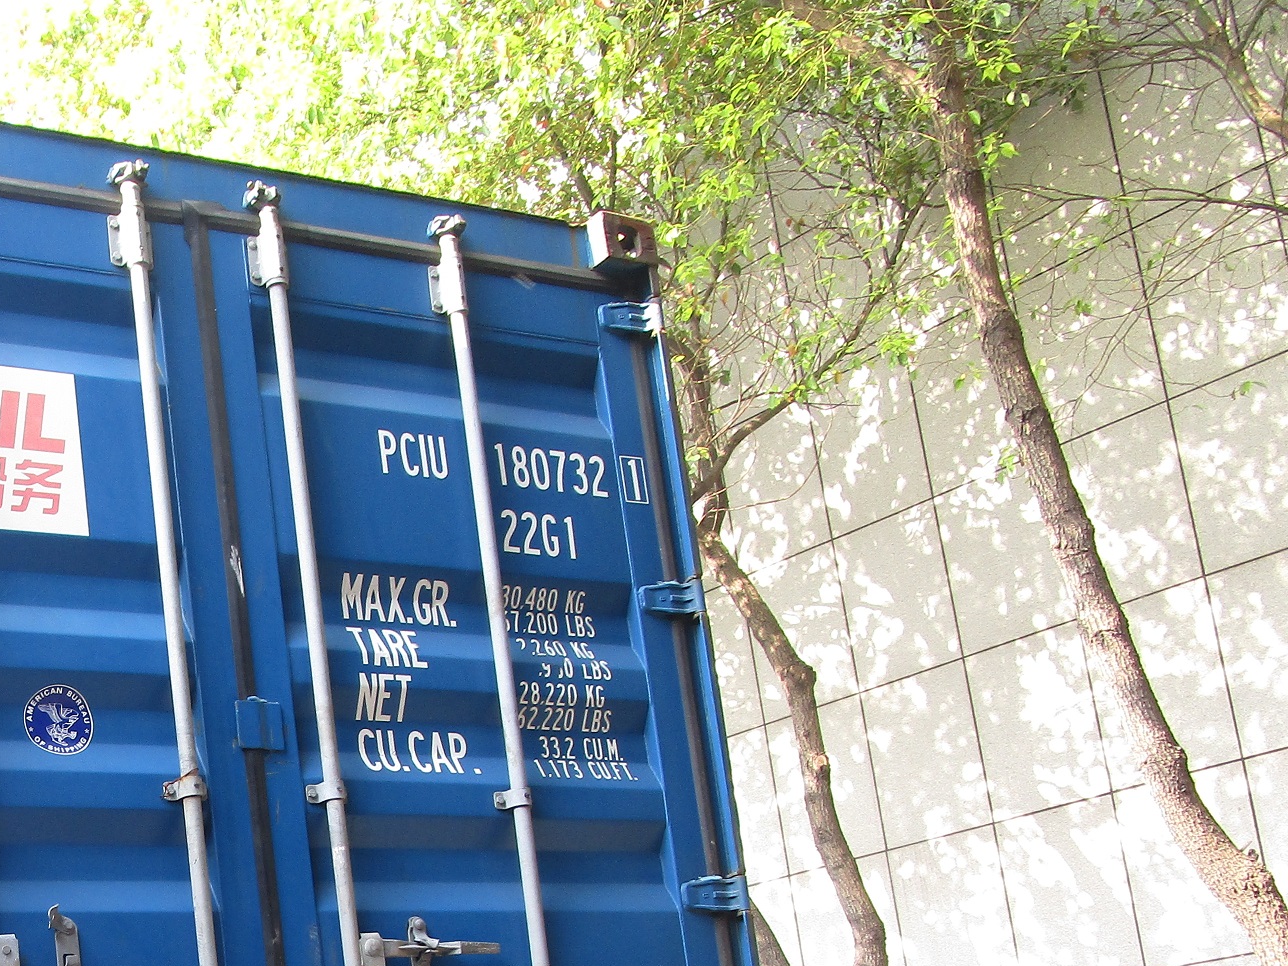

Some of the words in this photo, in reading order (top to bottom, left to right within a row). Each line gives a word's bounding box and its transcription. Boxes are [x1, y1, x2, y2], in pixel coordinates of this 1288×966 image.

[377, 429, 449, 480] PCIU
[494, 443, 610, 499] 180732
[500, 509, 577, 560] 22G1
[341, 572, 457, 628] MAX.GR.
[565, 590, 586, 614] KG
[346, 626, 428, 669] TARE
[569, 641, 595, 659] KG
[565, 614, 596, 638] LBS
[581, 660, 612, 681] LBS
[26, 687, 63, 722] AMERICAN
[66, 690, 91, 724] BUREAU
[355, 673, 412, 723] NET
[585, 684, 605, 708] KG
[581, 709, 612, 733] LBS
[34, 736, 46, 746] OF
[48, 737, 88, 753] SHIPPING
[357, 728, 482, 775] CU.CAP.
[538, 736, 576, 760] 33.2
[583, 737, 624, 761] CU.M.
